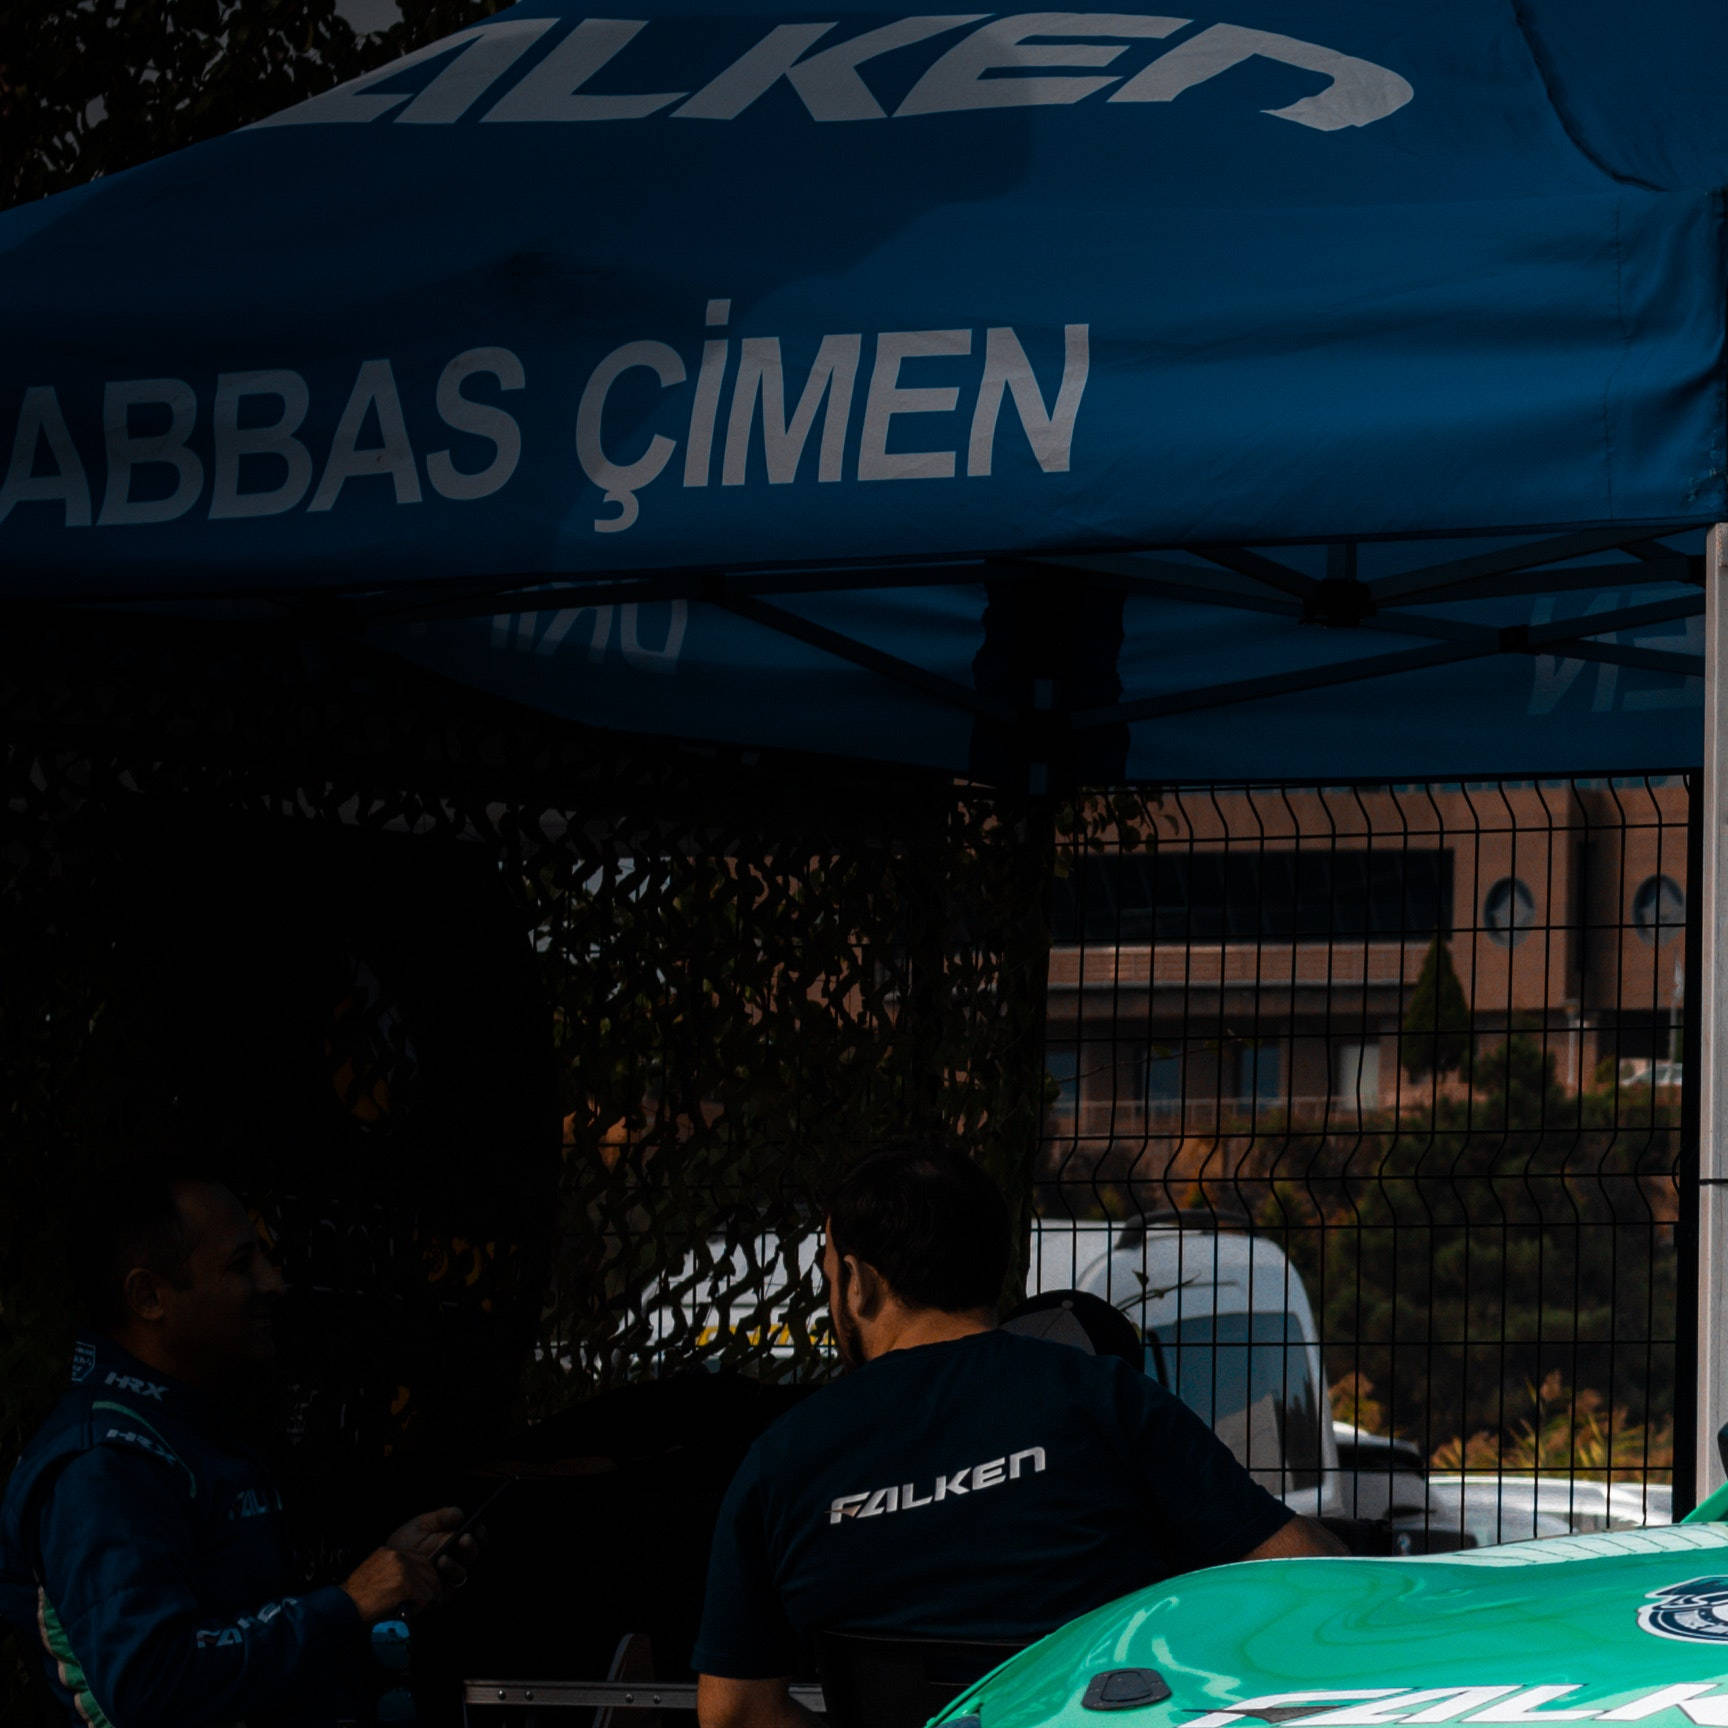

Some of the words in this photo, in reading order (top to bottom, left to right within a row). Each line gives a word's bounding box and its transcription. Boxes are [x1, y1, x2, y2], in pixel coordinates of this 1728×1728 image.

[232, 14, 1416, 132] ALKEN
[0, 345, 526, 526] ABBAS
[574, 298, 1090, 533] ÇİMEN
[824, 1445, 1046, 1525] FALKEN
